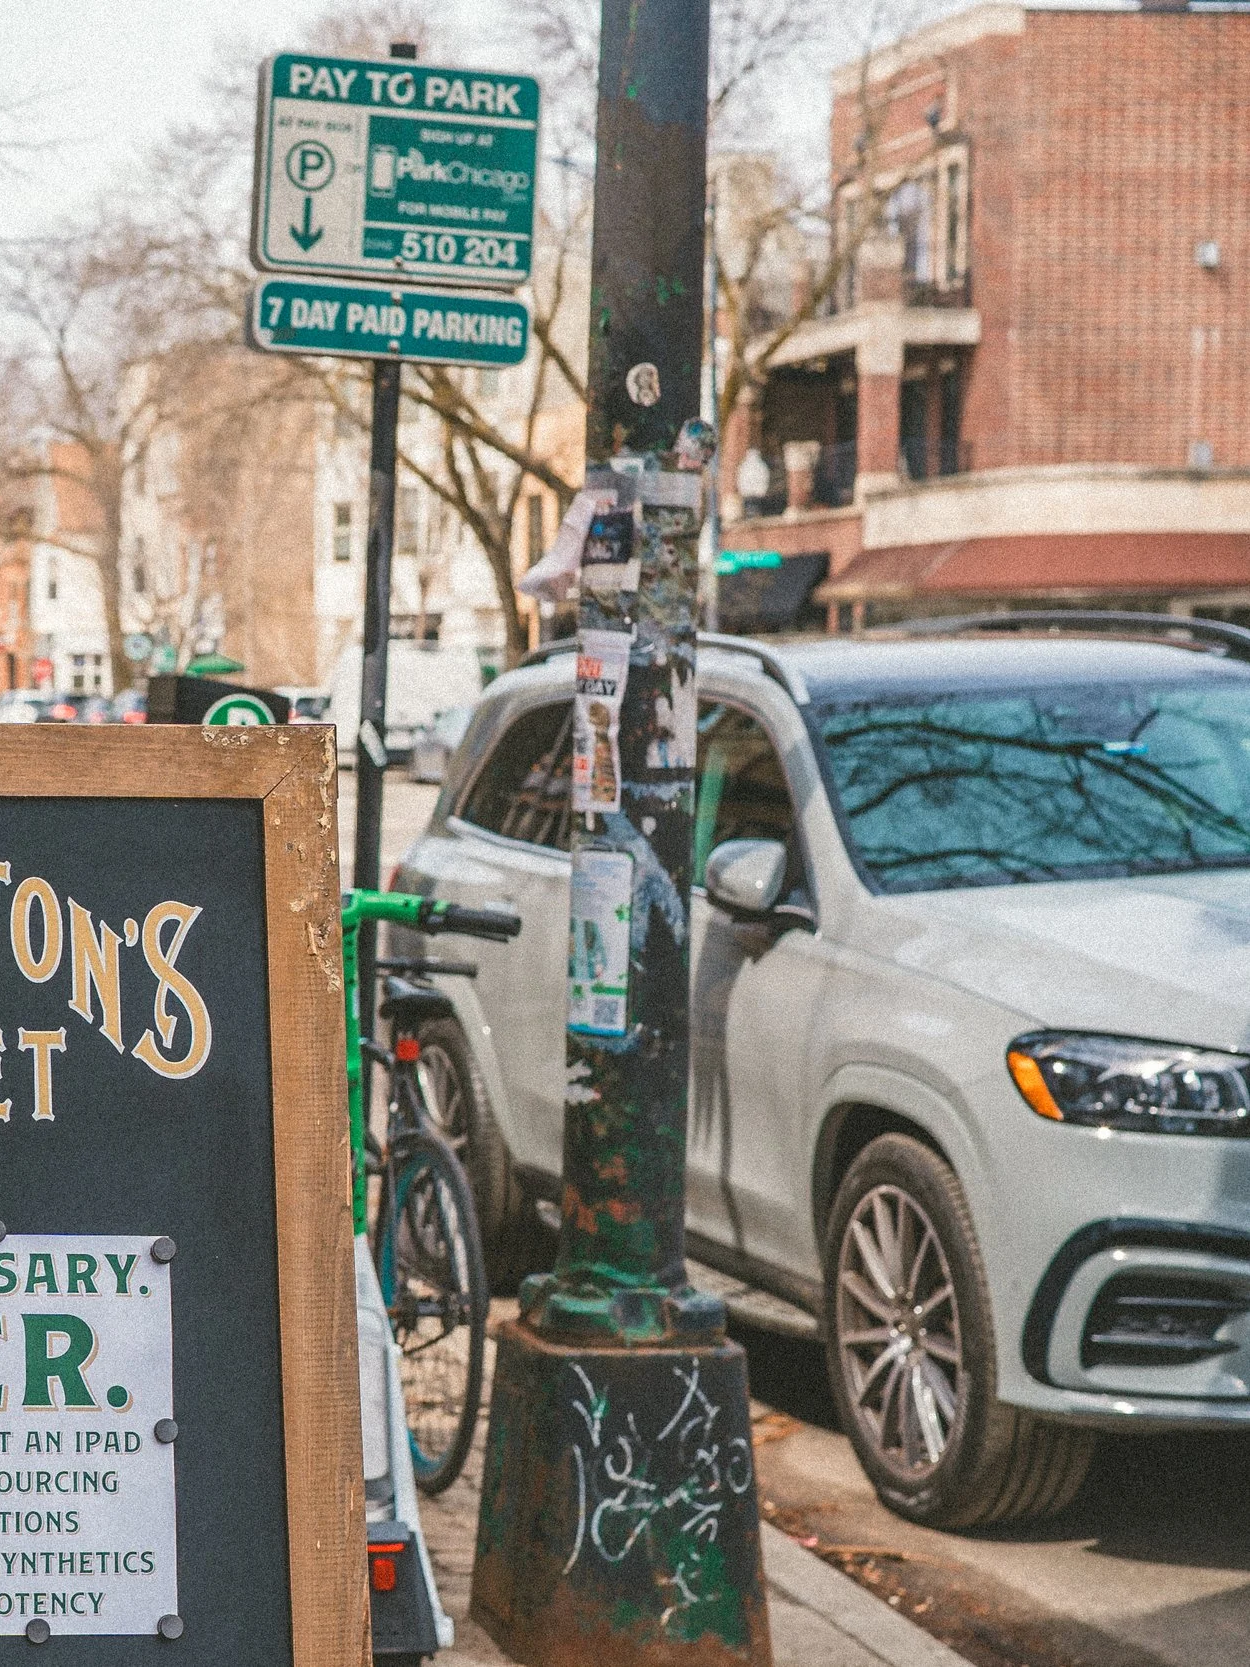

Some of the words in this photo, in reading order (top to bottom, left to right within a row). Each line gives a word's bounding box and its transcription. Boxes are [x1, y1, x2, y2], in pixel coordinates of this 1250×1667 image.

[289, 63, 357, 100] PAY
[365, 70, 416, 105] TO
[424, 76, 522, 116] PARK
[401, 232, 458, 262] 510
[463, 237, 519, 267] 204
[267, 297, 285, 325] 7
[290, 298, 341, 332] DAY
[346, 303, 406, 337] PAID
[413, 308, 522, 347] PARKING
[24, 1431, 63, 1454] AN
[75, 1431, 142, 1454] IPAD
